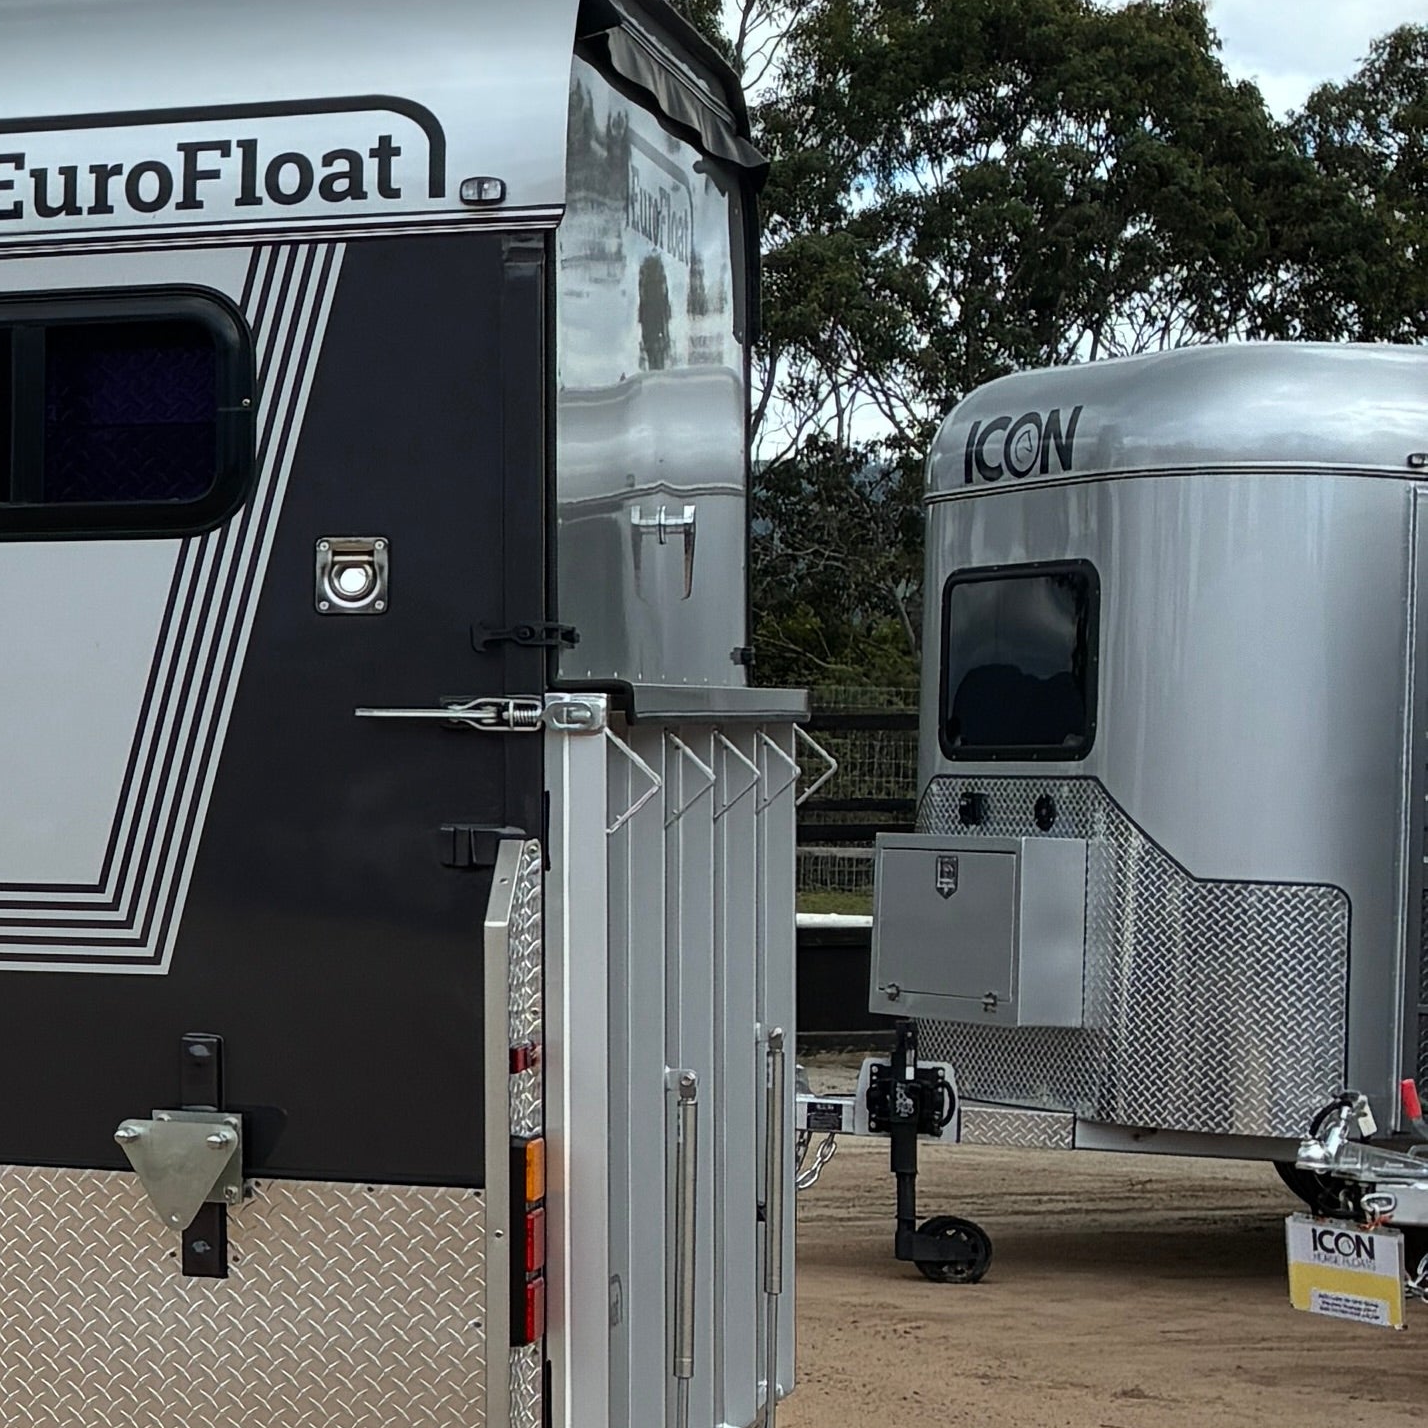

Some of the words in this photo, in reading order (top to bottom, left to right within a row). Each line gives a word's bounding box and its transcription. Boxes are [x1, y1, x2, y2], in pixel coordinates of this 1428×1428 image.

[631, 164, 689, 267] EuroFloat
[964, 405, 1084, 484] ICON
[1311, 1227, 1376, 1261] ICON
